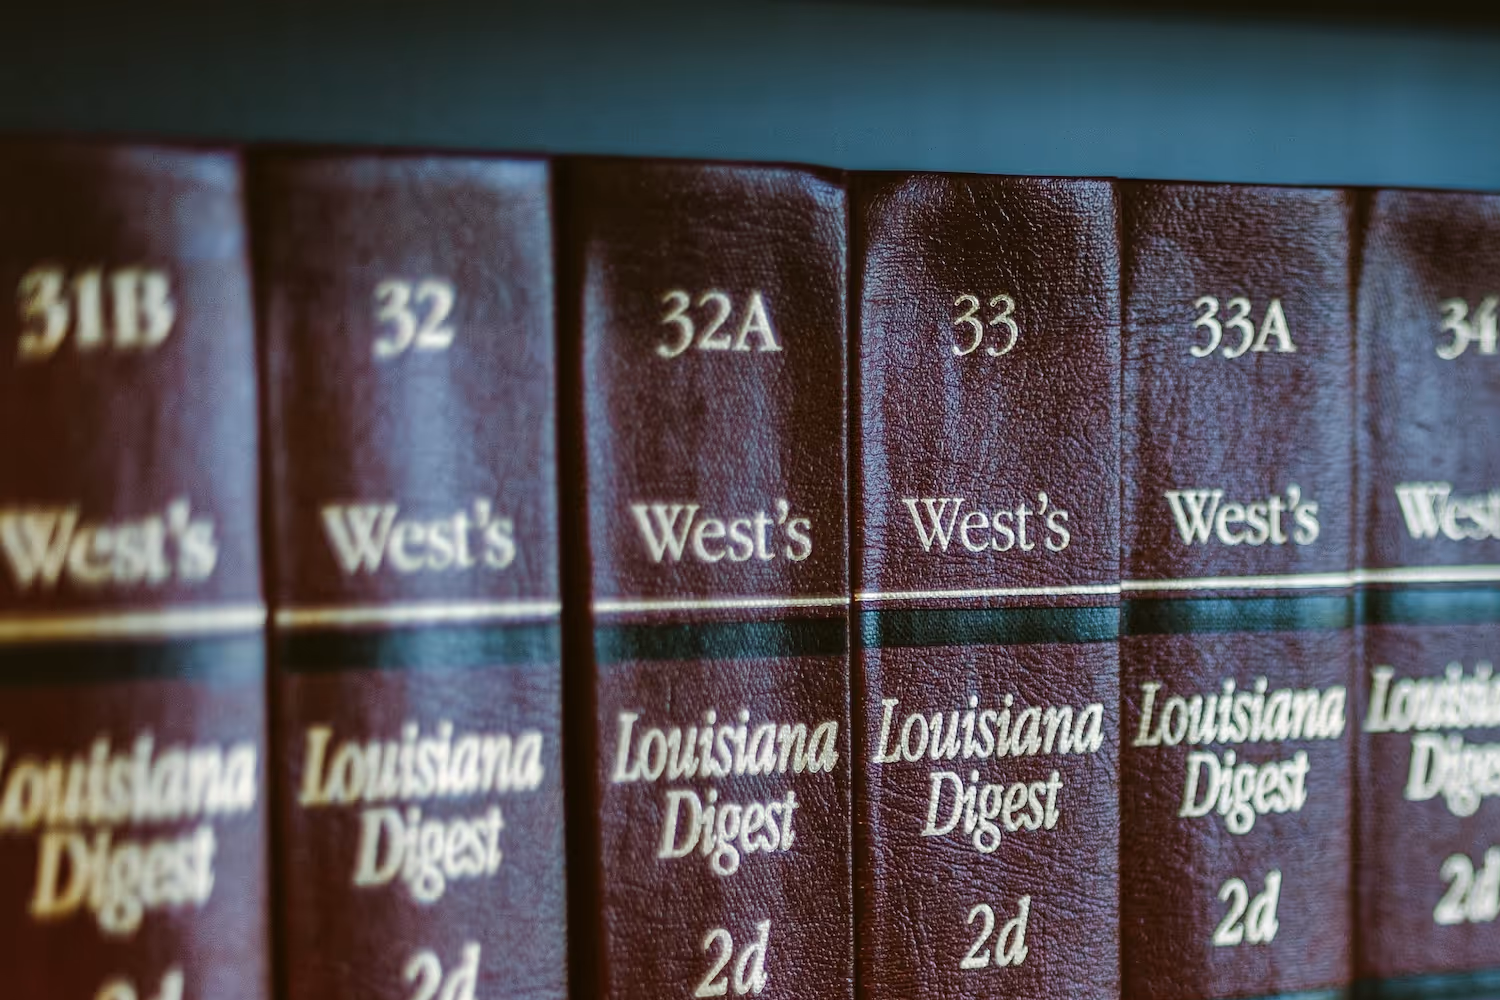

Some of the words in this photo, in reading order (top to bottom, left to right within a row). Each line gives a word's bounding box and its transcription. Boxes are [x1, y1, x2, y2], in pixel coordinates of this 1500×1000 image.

[18, 268, 175, 360] 31B
[373, 279, 456, 360] 32
[656, 289, 783, 358] 32A
[951, 293, 1019, 357] 33
[1189, 296, 1298, 360] 33A
[1435, 297, 1500, 361] 34
[0, 497, 219, 587] West's
[321, 500, 516, 575] West's
[631, 498, 813, 564] West's
[902, 491, 1071, 554] West's
[1164, 484, 1320, 547] West's
[613, 709, 840, 784] Louisiana
[871, 693, 1104, 765] Louisiana
[1133, 676, 1346, 748] Louisiana
[0, 733, 257, 830] ouisiana
[300, 722, 544, 806] Louisiana
[1179, 749, 1311, 835] Digest
[657, 790, 798, 877] Digest
[921, 769, 1063, 854] Digest
[30, 826, 217, 935] Digest
[354, 805, 504, 904] Digest
[960, 895, 1031, 970] 2d
[1213, 870, 1283, 946] 2d
[695, 920, 771, 998] 2d
